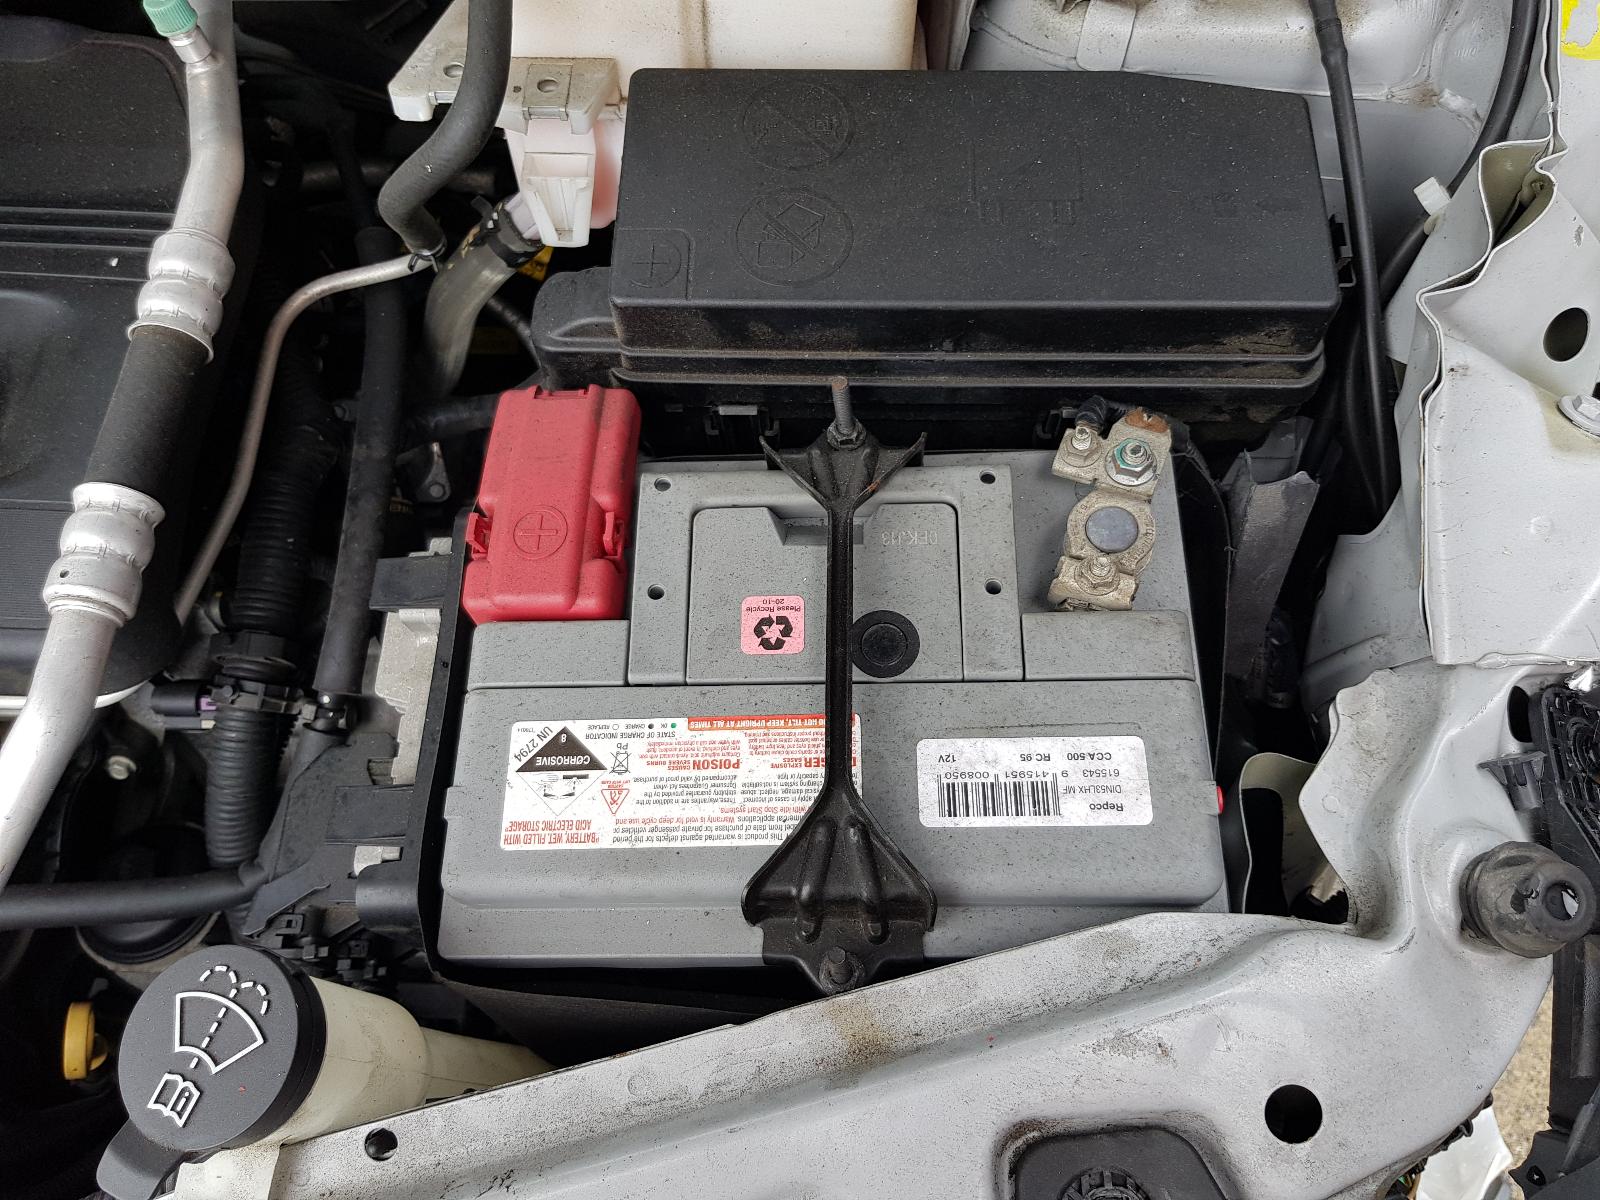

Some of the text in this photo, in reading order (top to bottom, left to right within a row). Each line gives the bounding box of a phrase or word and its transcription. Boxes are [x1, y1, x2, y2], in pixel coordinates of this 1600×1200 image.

[690, 721, 711, 729] TIMES
[736, 719, 765, 727] UPRIGHT
[561, 733, 567, 742] 8
[585, 732, 618, 740] INDICATOR
[647, 731, 655, 739] OF
[513, 725, 553, 763] UN 2794
[616, 742, 628, 750] Pb
[535, 755, 591, 765] CORROSIVE
[938, 754, 956, 763] 12V
[1020, 753, 1050, 762] RC 95
[1067, 752, 1112, 761] CCA 500
[692, 759, 740, 770] POISON
[944, 771, 989, 780] 008950
[1004, 771, 1049, 779] 415951
[1082, 768, 1119, 777] 615543
[1062, 784, 1121, 794] DIN53LHX MF
[719, 805, 746, 815] systems.
[748, 807, 762, 815] Start
[764, 806, 778, 814] Stop
[1089, 801, 1123, 812] Repco
[542, 820, 573, 831] ELECTRIC
[575, 820, 591, 830] ACID
[641, 817, 657, 825] cycle
[622, 827, 646, 835] vehicles
[648, 825, 680, 834] passenger
[682, 825, 702, 833] private
[715, 824, 743, 832] purchase
[504, 834, 521, 845] WITH
[523, 834, 546, 844] FILLED
[613, 834, 632, 844] period
[656, 834, 678, 843] defects
[680, 833, 702, 842] against
[744, 831, 769, 841] product
